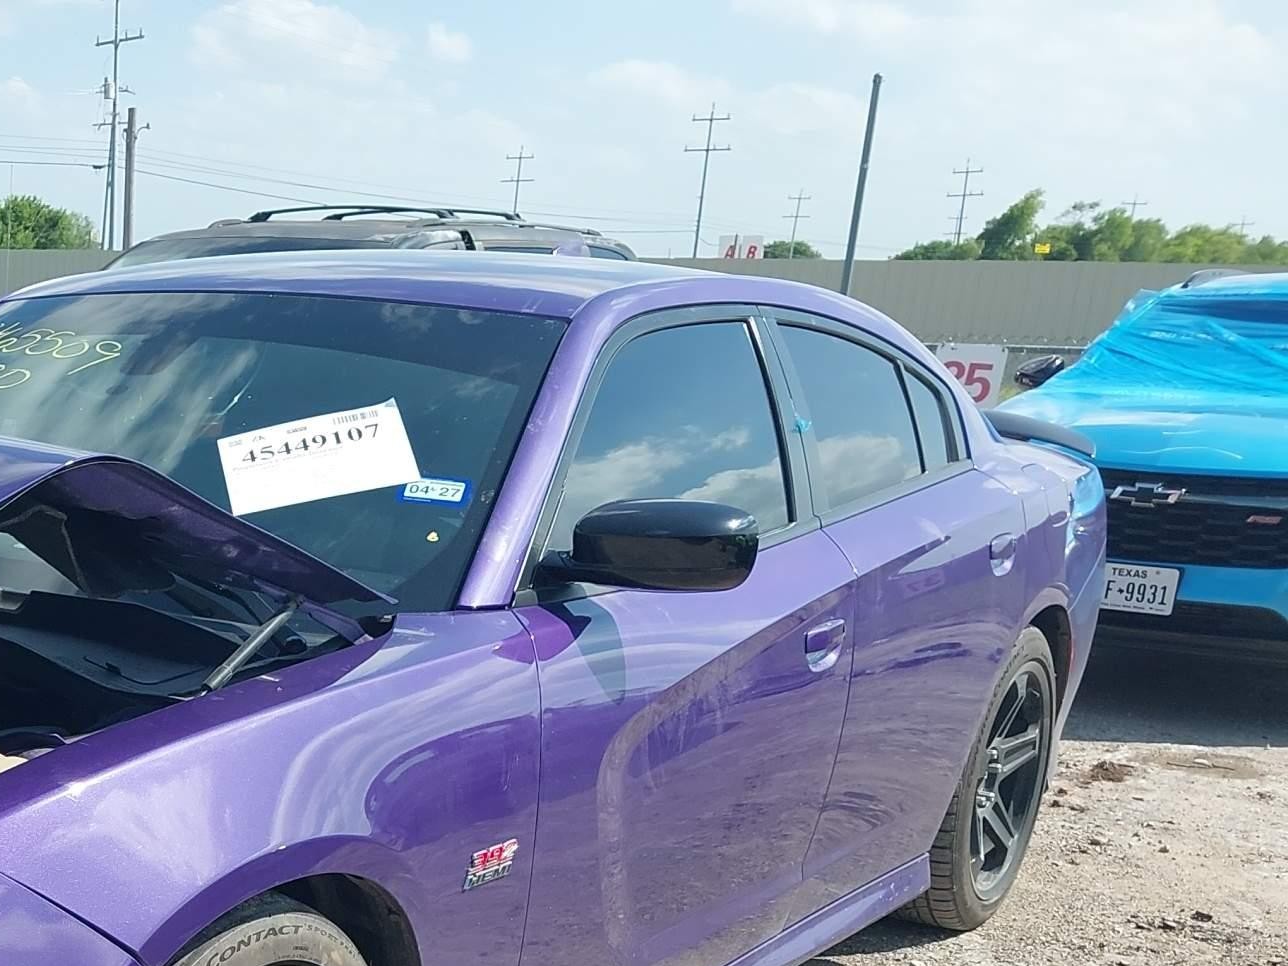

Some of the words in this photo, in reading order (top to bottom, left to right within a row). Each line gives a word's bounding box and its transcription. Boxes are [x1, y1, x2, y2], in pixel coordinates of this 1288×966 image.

[242, 423, 379, 463] 45449107
[409, 484, 430, 495] 04
[438, 487, 461, 498] 27
[1112, 567, 1148, 579] TEXAS
